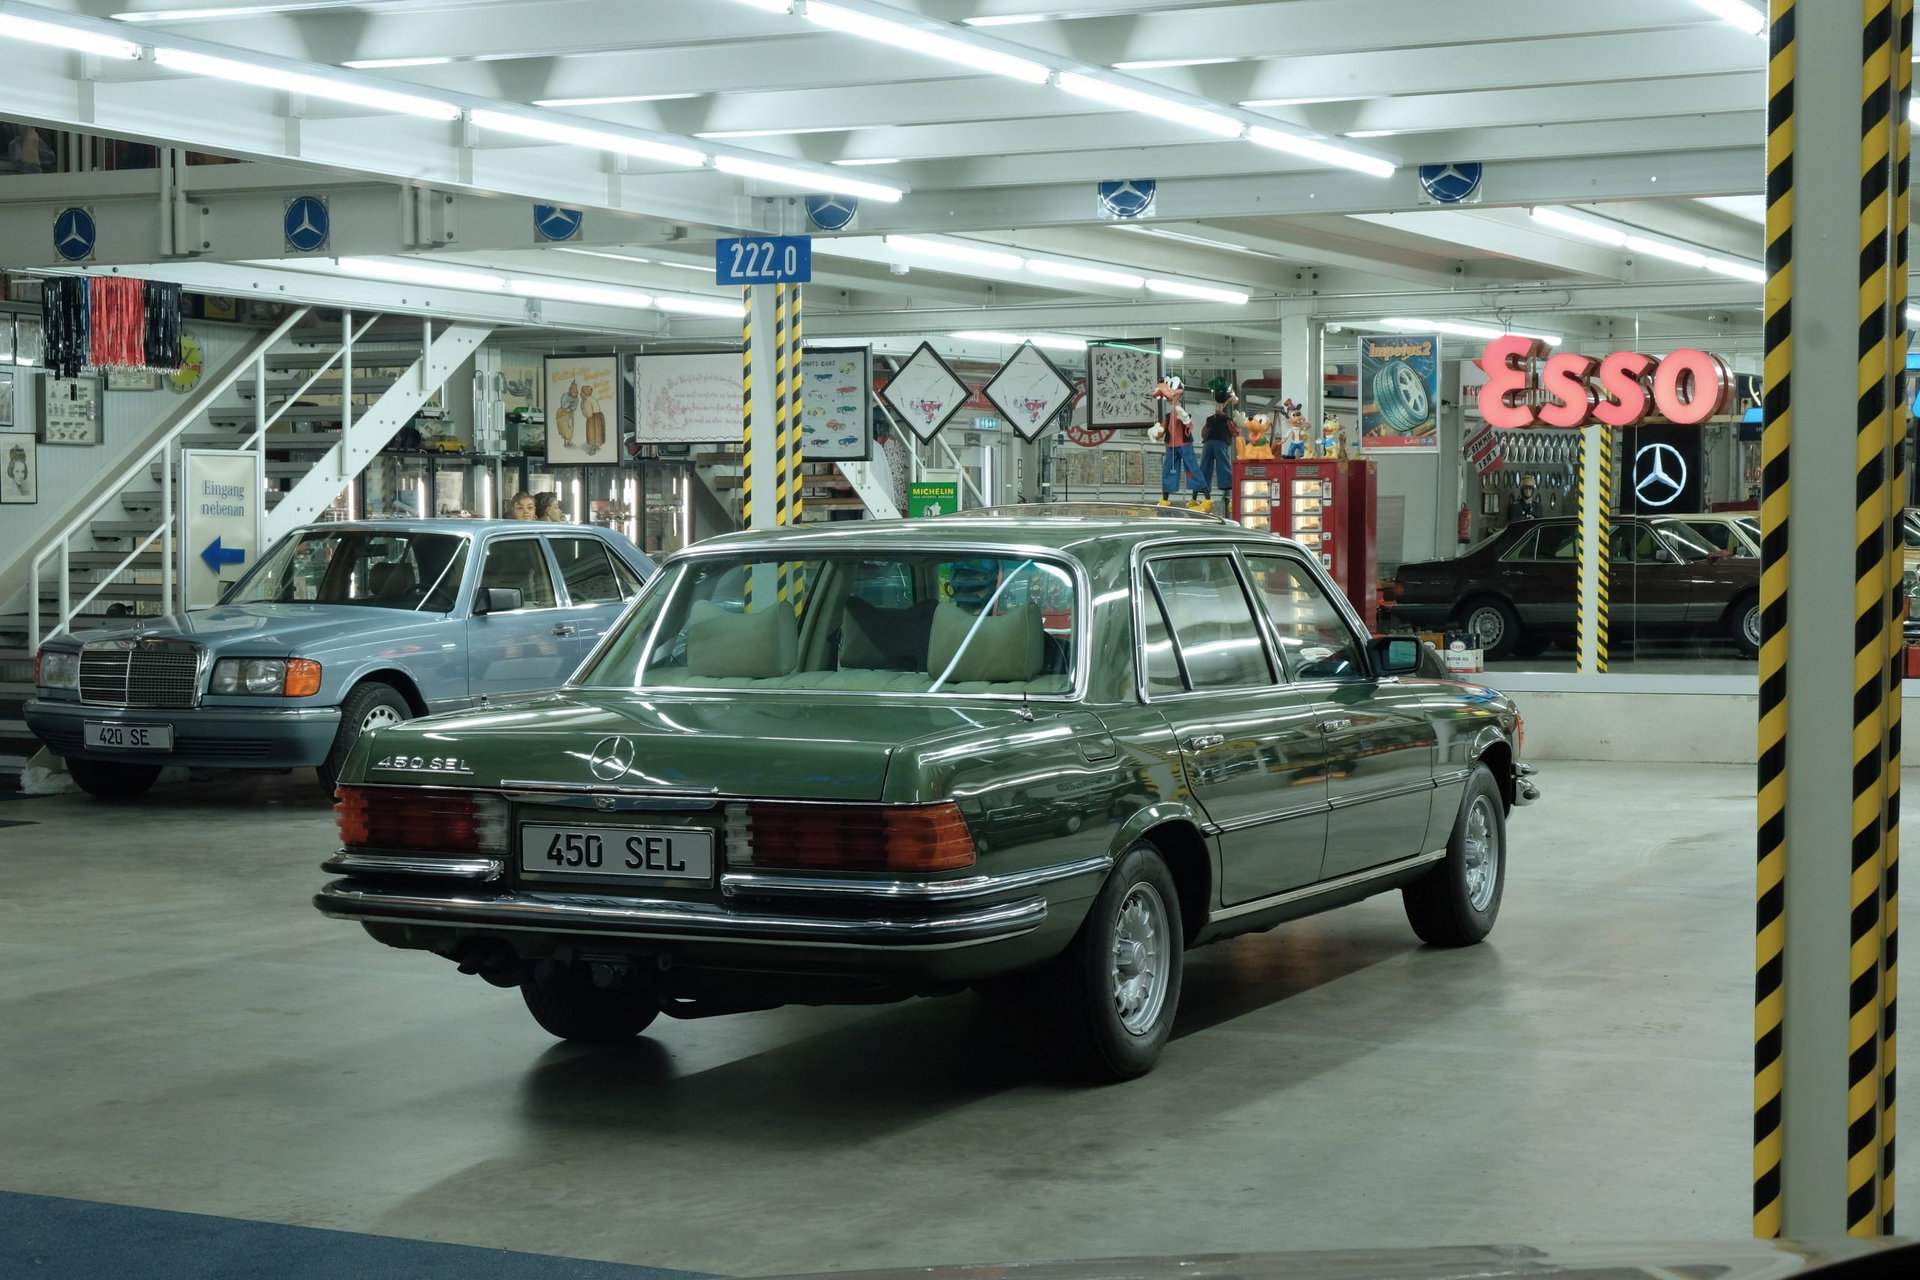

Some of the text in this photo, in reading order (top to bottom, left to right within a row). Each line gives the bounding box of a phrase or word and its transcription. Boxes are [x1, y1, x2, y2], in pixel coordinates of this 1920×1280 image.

[731, 242, 797, 279] 222,0
[204, 480, 245, 500] Eingang
[202, 501, 245, 517] nebenan
[100, 728, 150, 746] 420 SE
[378, 756, 470, 770] 450 SEL
[547, 833, 686, 871] 450 SEL
